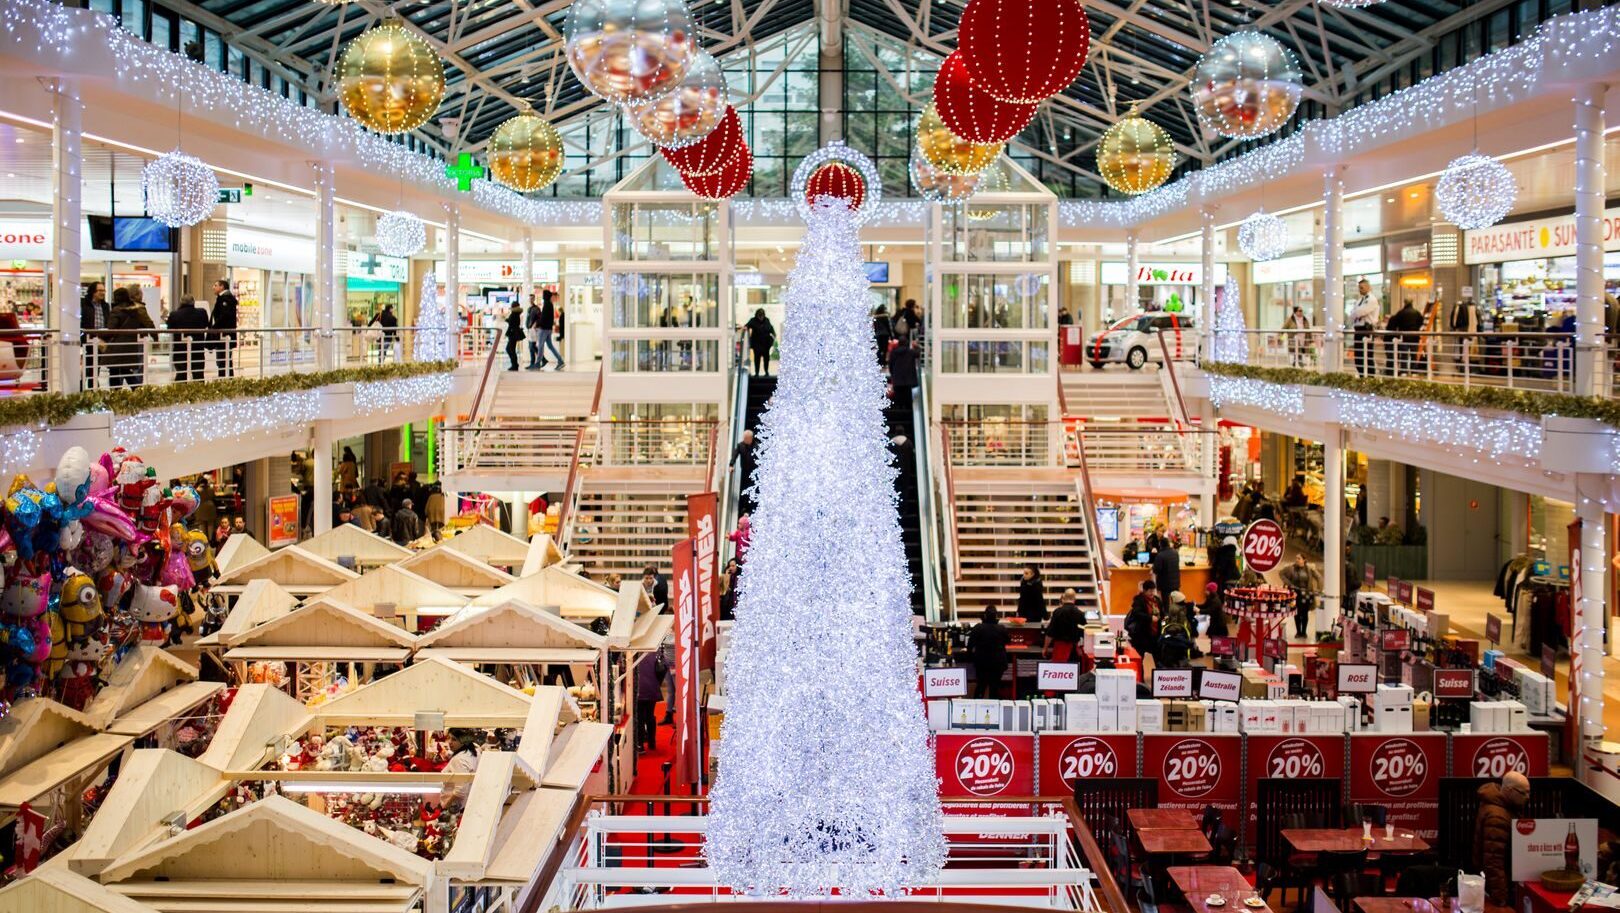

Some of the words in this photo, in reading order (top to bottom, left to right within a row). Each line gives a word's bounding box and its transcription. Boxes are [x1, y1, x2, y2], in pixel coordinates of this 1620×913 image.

[0, 234, 45, 244] one
[1245, 533, 1282, 557] 20%
[1042, 670, 1074, 680] France
[1157, 675, 1188, 683] Nouvelle-
[1347, 674, 1369, 683] ROSÉ
[930, 677, 960, 687] Suisse
[1204, 680, 1237, 691] Australie
[1438, 678, 1469, 688] Suisse
[1160, 684, 1185, 692] Zélande
[960, 752, 1009, 779] 20%
[1063, 751, 1113, 779] 20%
[1167, 753, 1217, 781] 20%
[1271, 753, 1321, 779] 20%
[1374, 753, 1424, 781] 20%
[1476, 752, 1526, 778] 20%
